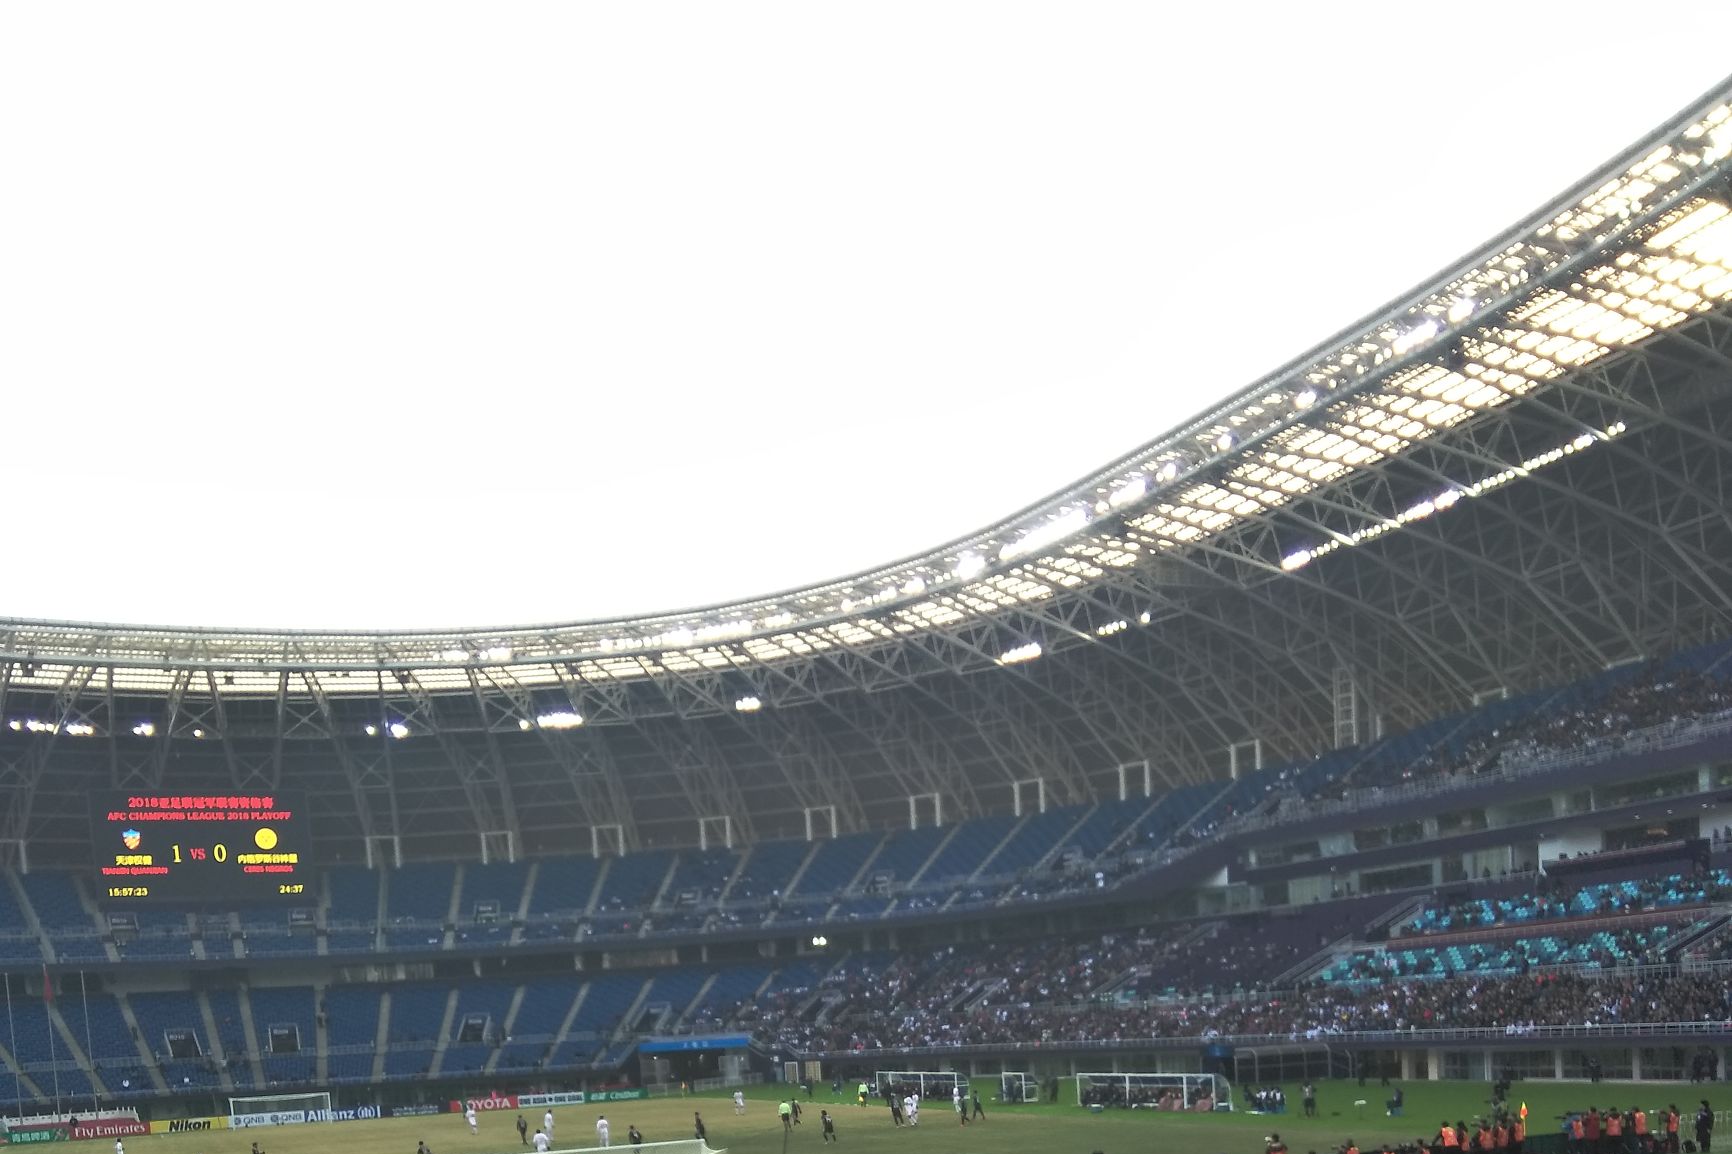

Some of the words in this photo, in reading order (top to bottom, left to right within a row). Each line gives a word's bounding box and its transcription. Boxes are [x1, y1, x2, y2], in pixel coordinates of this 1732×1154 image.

[107, 811, 127, 821] AFC
[128, 811, 185, 821] CHAMPIONS
[187, 811, 225, 821] LEAGUE
[251, 811, 292, 820] PLAYOFF
[171, 844, 182, 863] 1
[189, 848, 206, 860] VS
[213, 843, 227, 863] 0
[243, 1115, 265, 1125] QNB
[281, 1112, 302, 1122] QNB
[307, 1108, 355, 1122] Allianz
[74, 1126, 94, 1138] Fly
[96, 1122, 146, 1136] Emirates
[169, 1119, 211, 1132] Nikon
